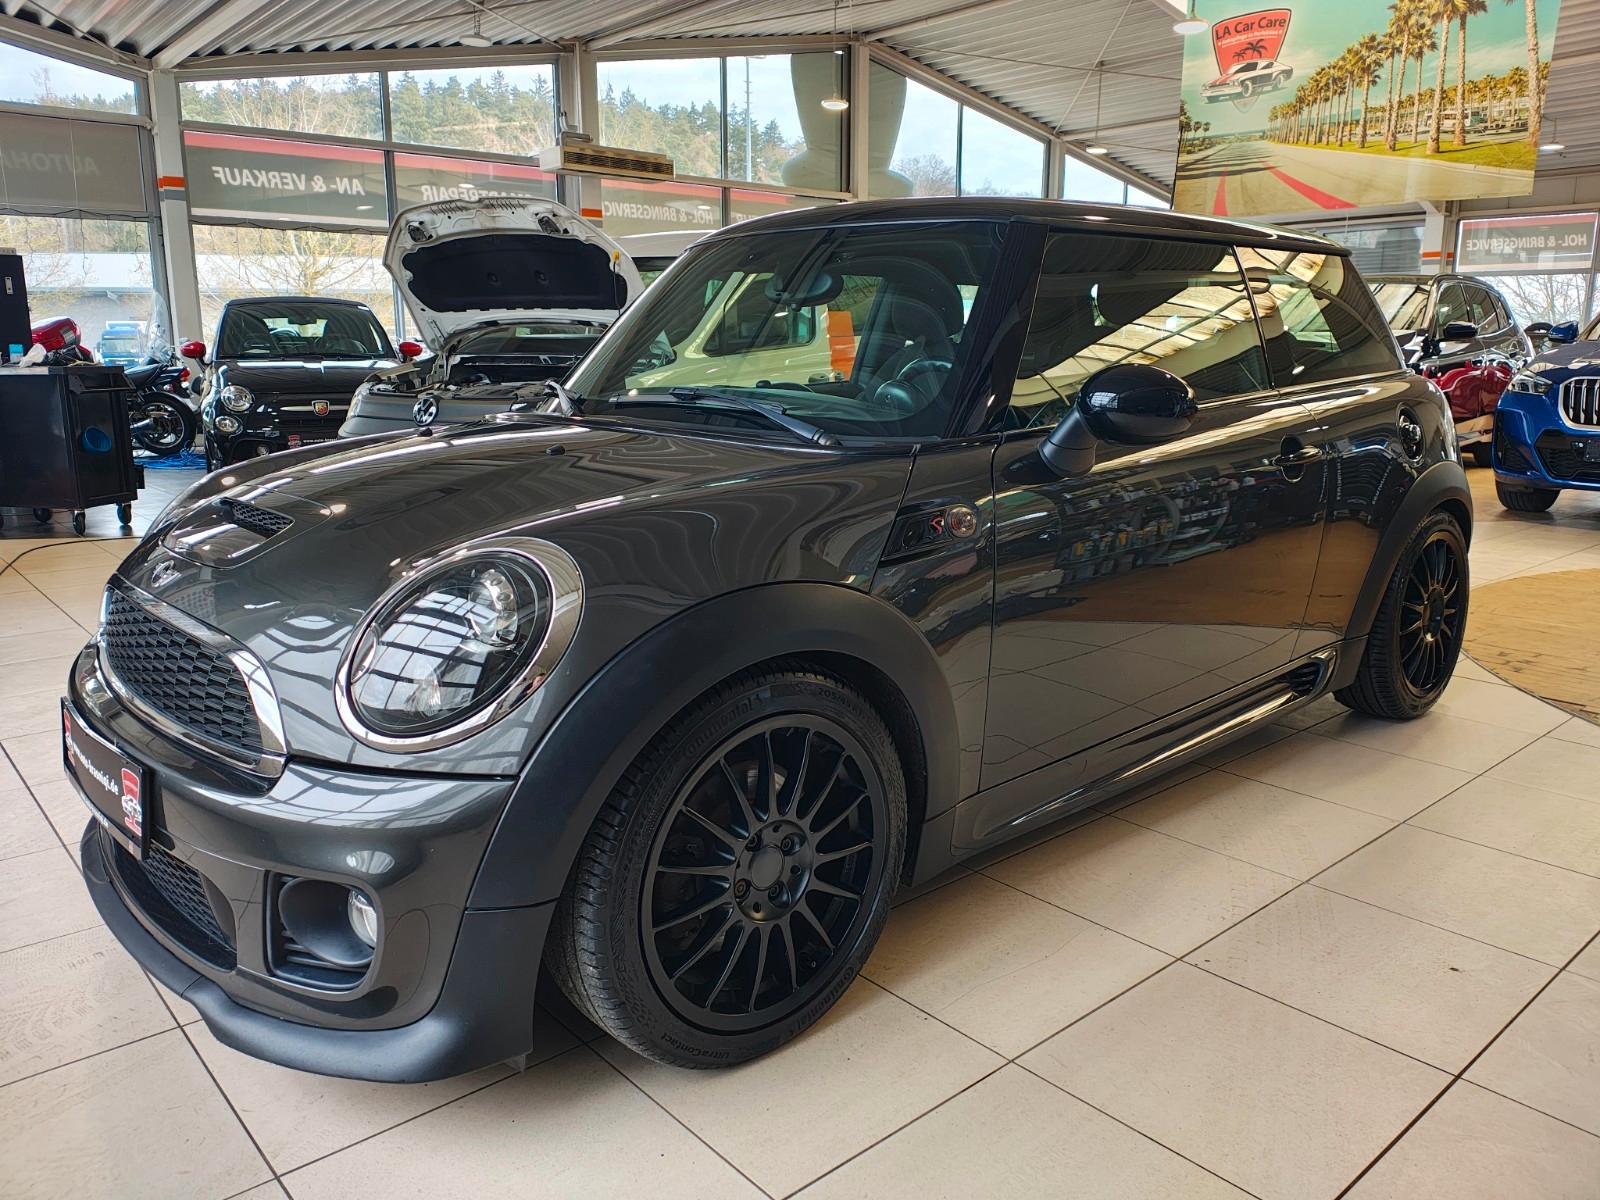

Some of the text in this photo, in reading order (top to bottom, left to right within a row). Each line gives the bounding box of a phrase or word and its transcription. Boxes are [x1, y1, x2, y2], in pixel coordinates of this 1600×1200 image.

[1215, 26, 1232, 40] LA
[1234, 21, 1255, 34] Car
[1257, 16, 1287, 30] Care
